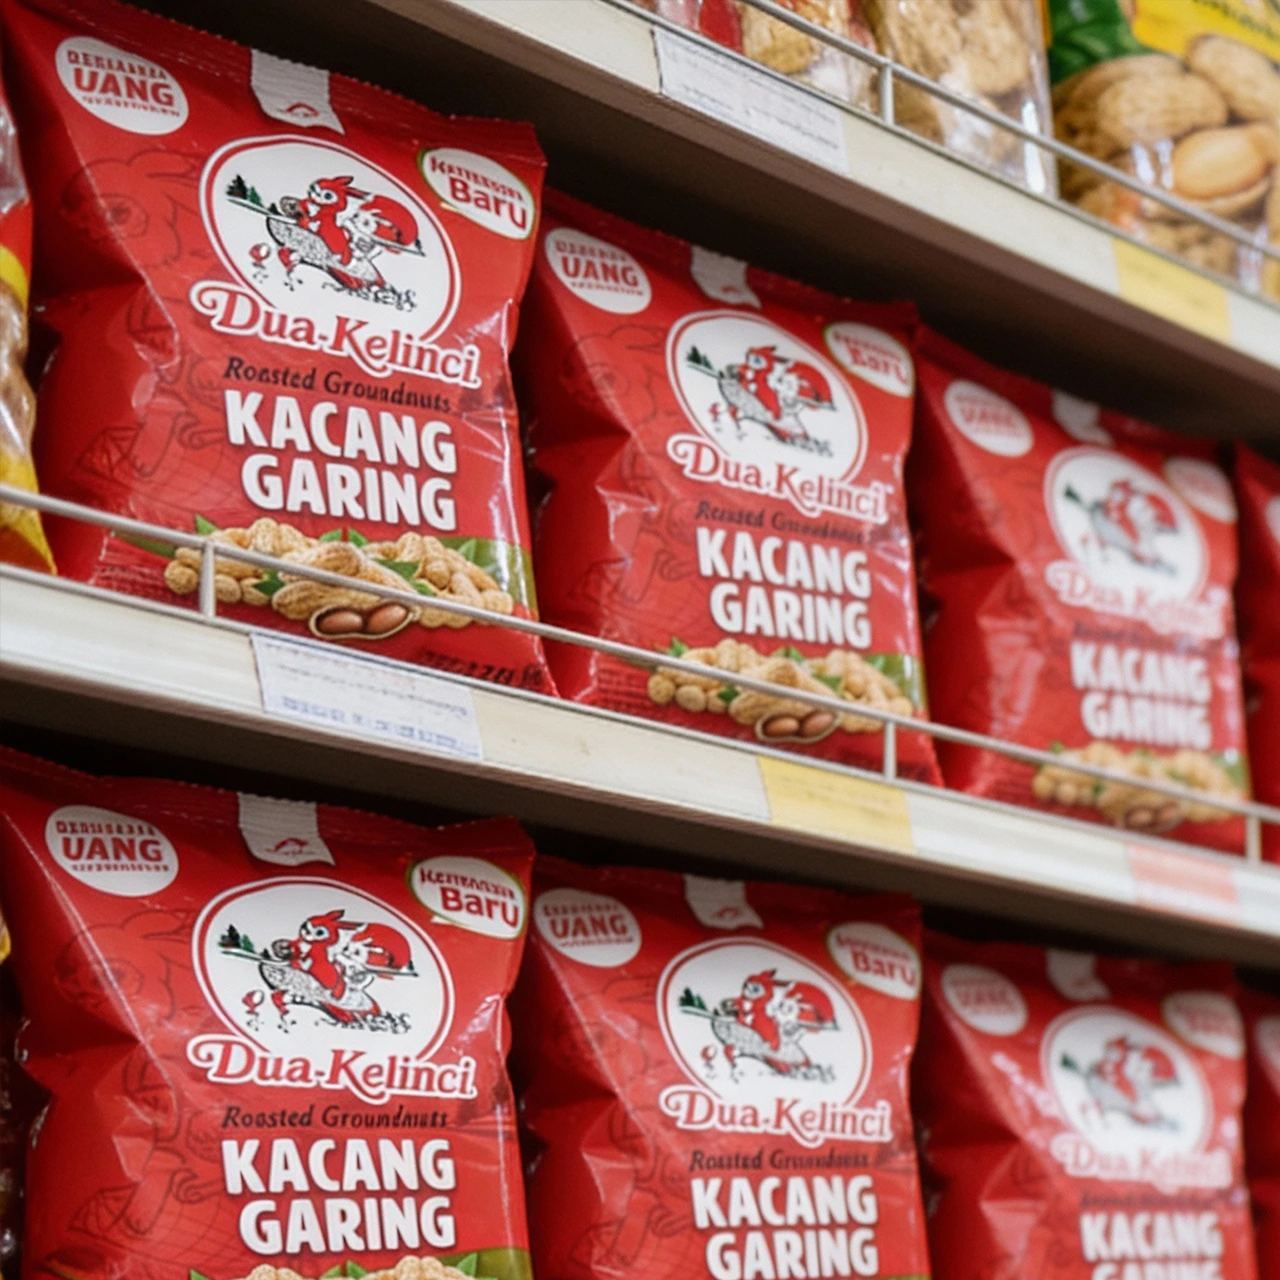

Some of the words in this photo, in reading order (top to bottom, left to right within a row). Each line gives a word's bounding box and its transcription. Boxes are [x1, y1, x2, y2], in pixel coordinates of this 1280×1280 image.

[73, 67, 175, 107] UANG
[449, 177, 526, 231] Baru
[561, 256, 639, 288] UANG
[193, 282, 481, 386] Dua-Kelinci
[224, 389, 458, 475] KACANG
[241, 453, 458, 532] GARING
[696, 527, 872, 600] KACANG
[709, 582, 872, 650] GARING
[61, 836, 163, 862] UANG
[441, 885, 519, 928] Baru
[549, 914, 628, 939] UANG
[190, 1038, 477, 1102] Dua-Kelinci
[221, 1104, 313, 1129] Roasted
[222, 1138, 456, 1195] KACANG
[239, 1196, 456, 1255] GARING
[690, 1174, 878, 1230] KACANG
[1079, 1211, 1223, 1262] KACANG
